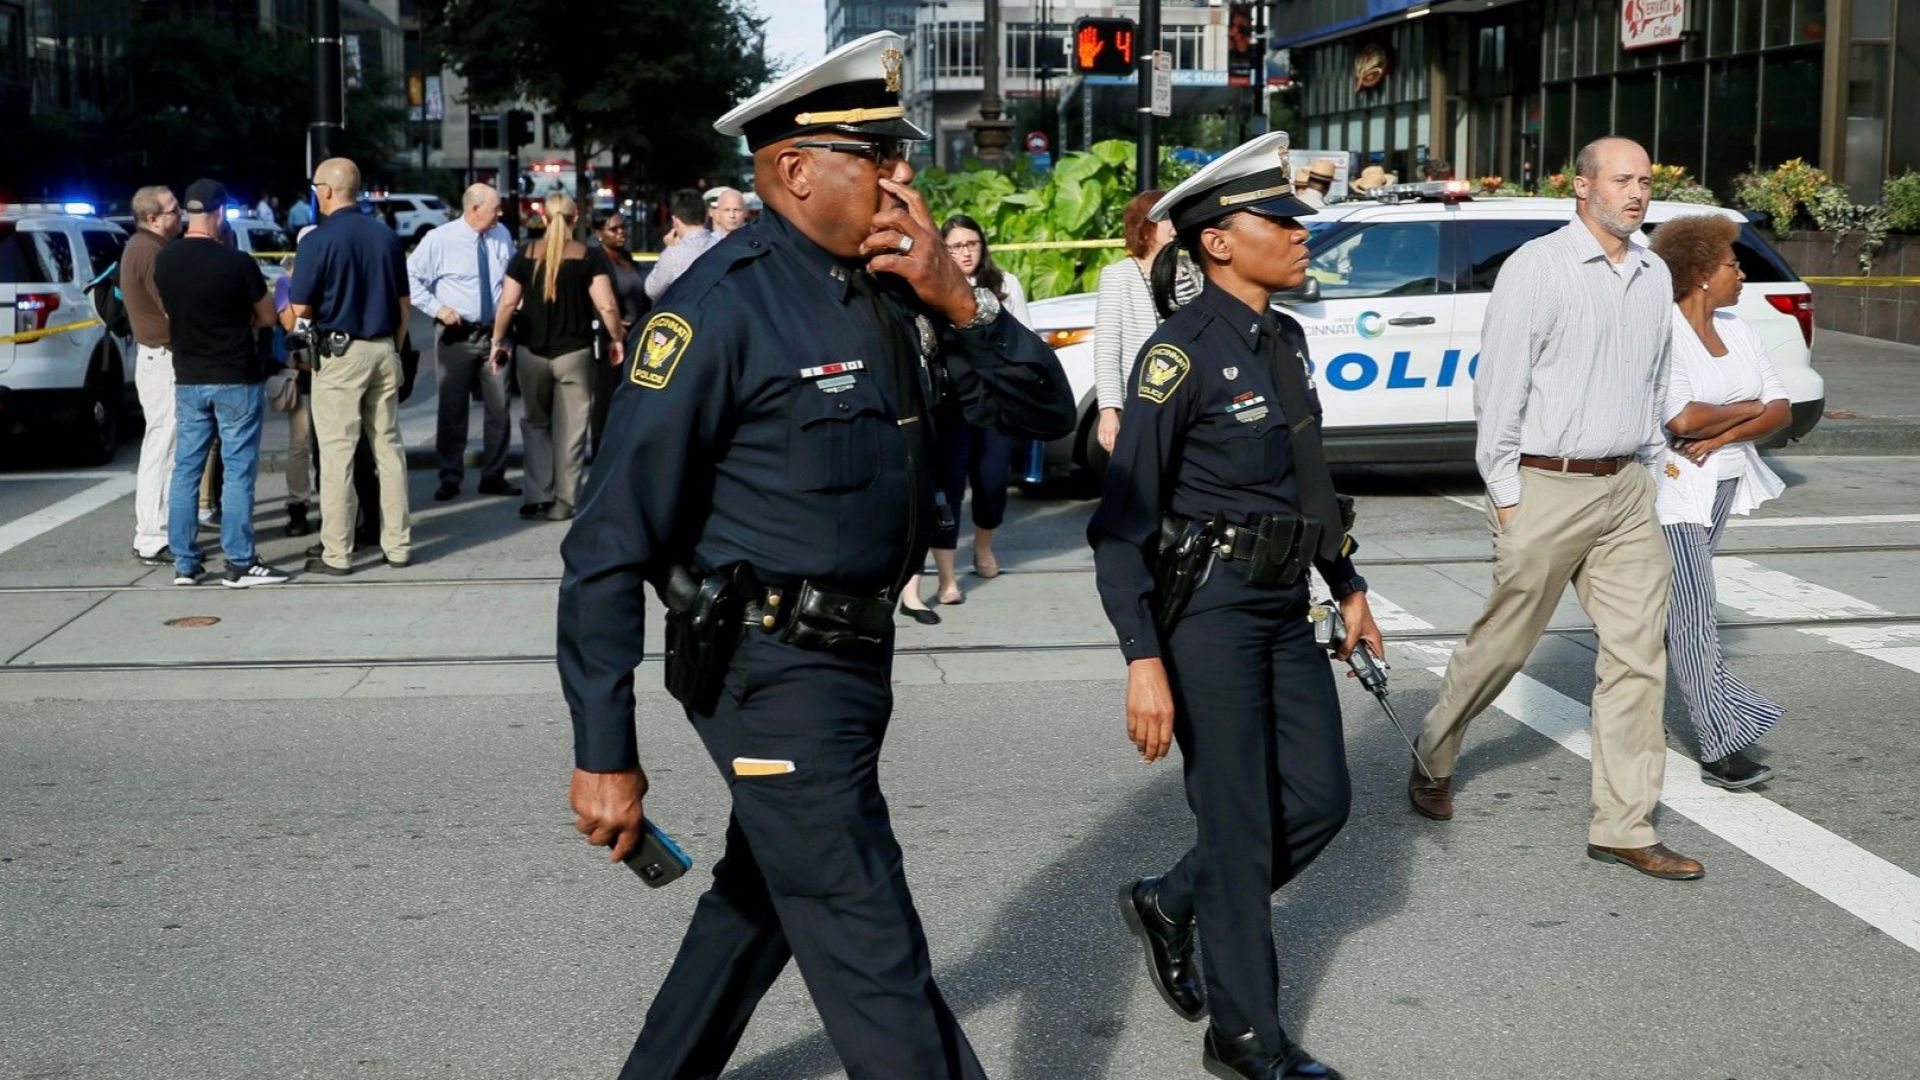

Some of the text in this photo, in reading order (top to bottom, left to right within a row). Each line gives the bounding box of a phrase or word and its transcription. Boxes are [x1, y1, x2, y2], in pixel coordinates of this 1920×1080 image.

[1115, 31, 1131, 63] 4
[1195, 71, 1228, 84] STAG
[1304, 324, 1354, 336] CINNATI
[635, 368, 665, 384] POLICE
[1308, 349, 1480, 392] OLI
